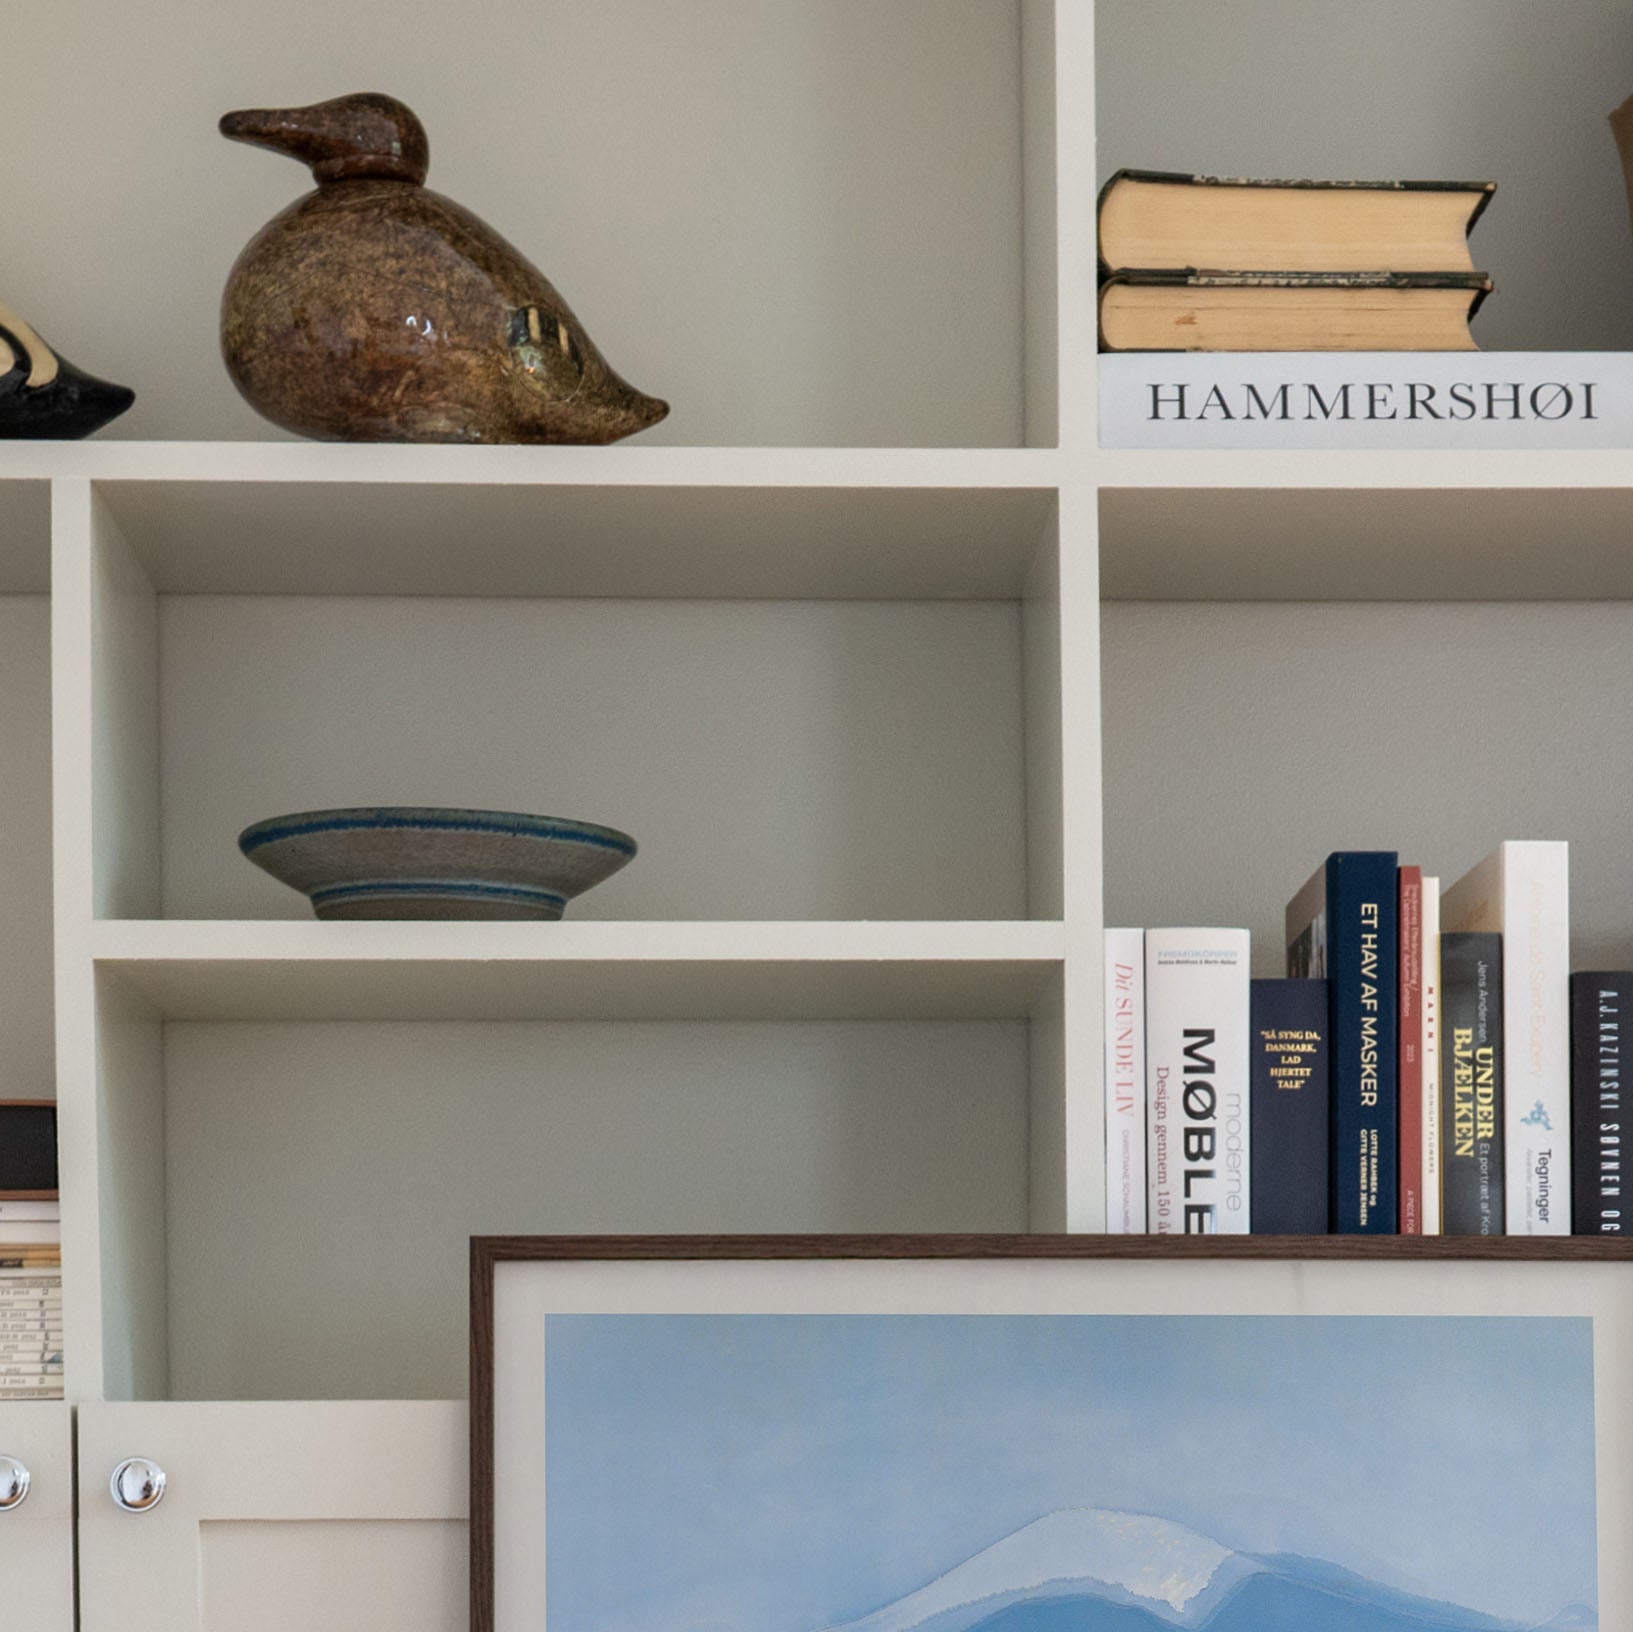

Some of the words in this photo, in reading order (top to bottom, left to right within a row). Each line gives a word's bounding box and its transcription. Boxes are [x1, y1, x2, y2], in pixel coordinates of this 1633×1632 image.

[1146, 383, 1598, 420] HAMMERSHØI
[1361, 903, 1377, 929] ET
[1114, 963, 1133, 991] Dit
[1361, 934, 1377, 978] HAV
[1478, 961, 1488, 987] Jens
[1361, 983, 1377, 1011] AF
[1478, 991, 1489, 1042] Andersen
[1115, 997, 1133, 1073] SUNDE
[1361, 1017, 1377, 1106] MASKER
[1454, 1028, 1474, 1156] BJÆLKEN
[1476, 1046, 1493, 1138] UNDER
[1600, 1024, 1619, 1109] KAZINSKI
[1115, 1082, 1134, 1117] LIV
[1155, 1067, 1169, 1120] Design
[1155, 1125, 1168, 1184] gennem
[1225, 1094, 1244, 1211] moderne
[1600, 1124, 1620, 1196] SØVNEN
[1158, 1191, 1170, 1216] 150
[1537, 1149, 1552, 1222] Tegninger
